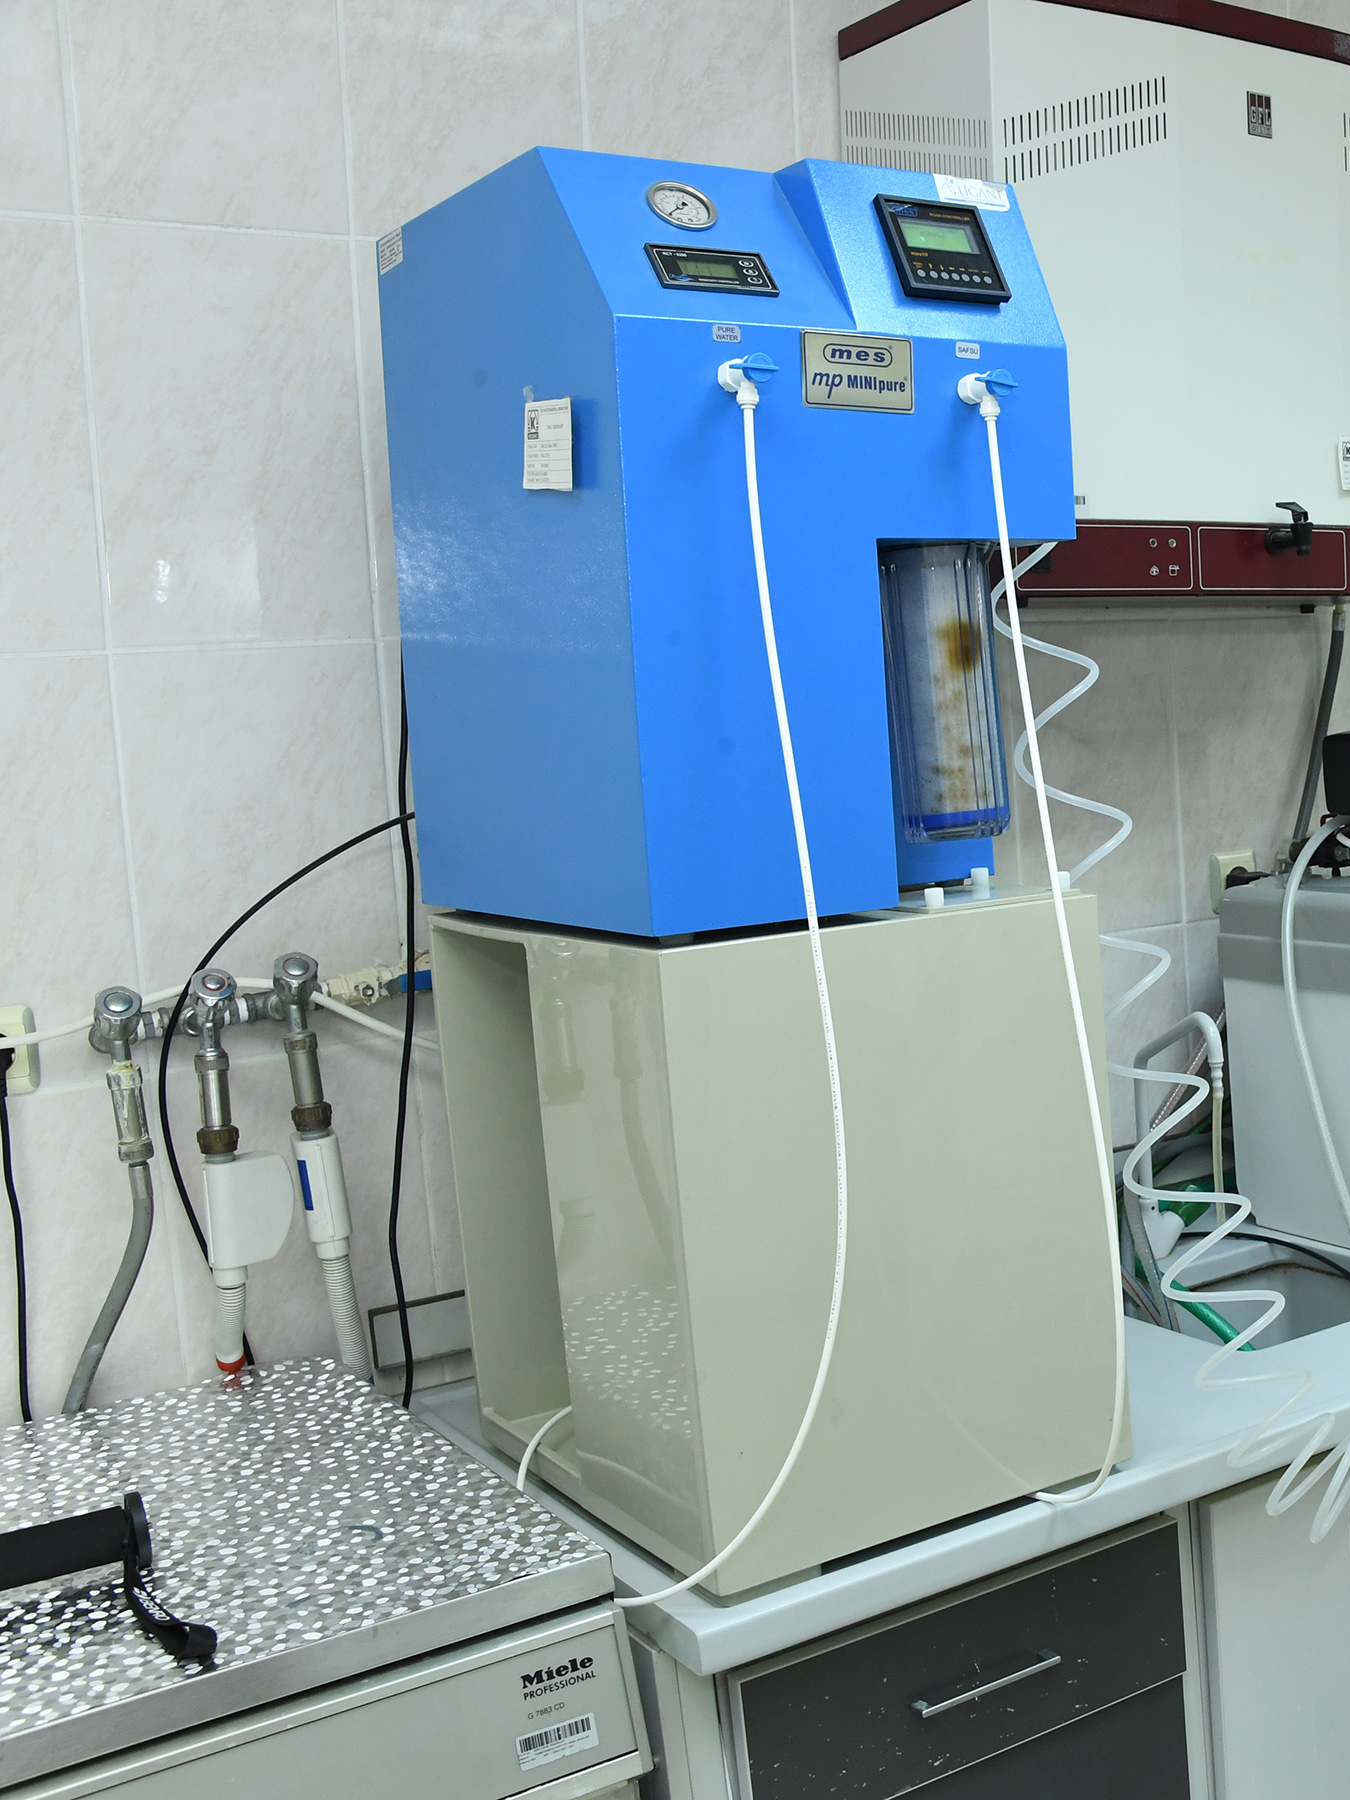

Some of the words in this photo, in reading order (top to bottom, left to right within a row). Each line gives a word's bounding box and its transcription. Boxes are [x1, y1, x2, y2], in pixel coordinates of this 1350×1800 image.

[1250, 105, 1272, 127] GFL
[830, 348, 886, 363] mes
[957, 346, 979, 355] SAFSU
[811, 372, 843, 399] mp
[520, 1656, 594, 1690] Miele
[523, 1670, 597, 1701] PROFESSIONAL
[527, 1712, 535, 1720] G
[535, 1706, 553, 1717] 7883
[554, 1701, 566, 1711] CD
